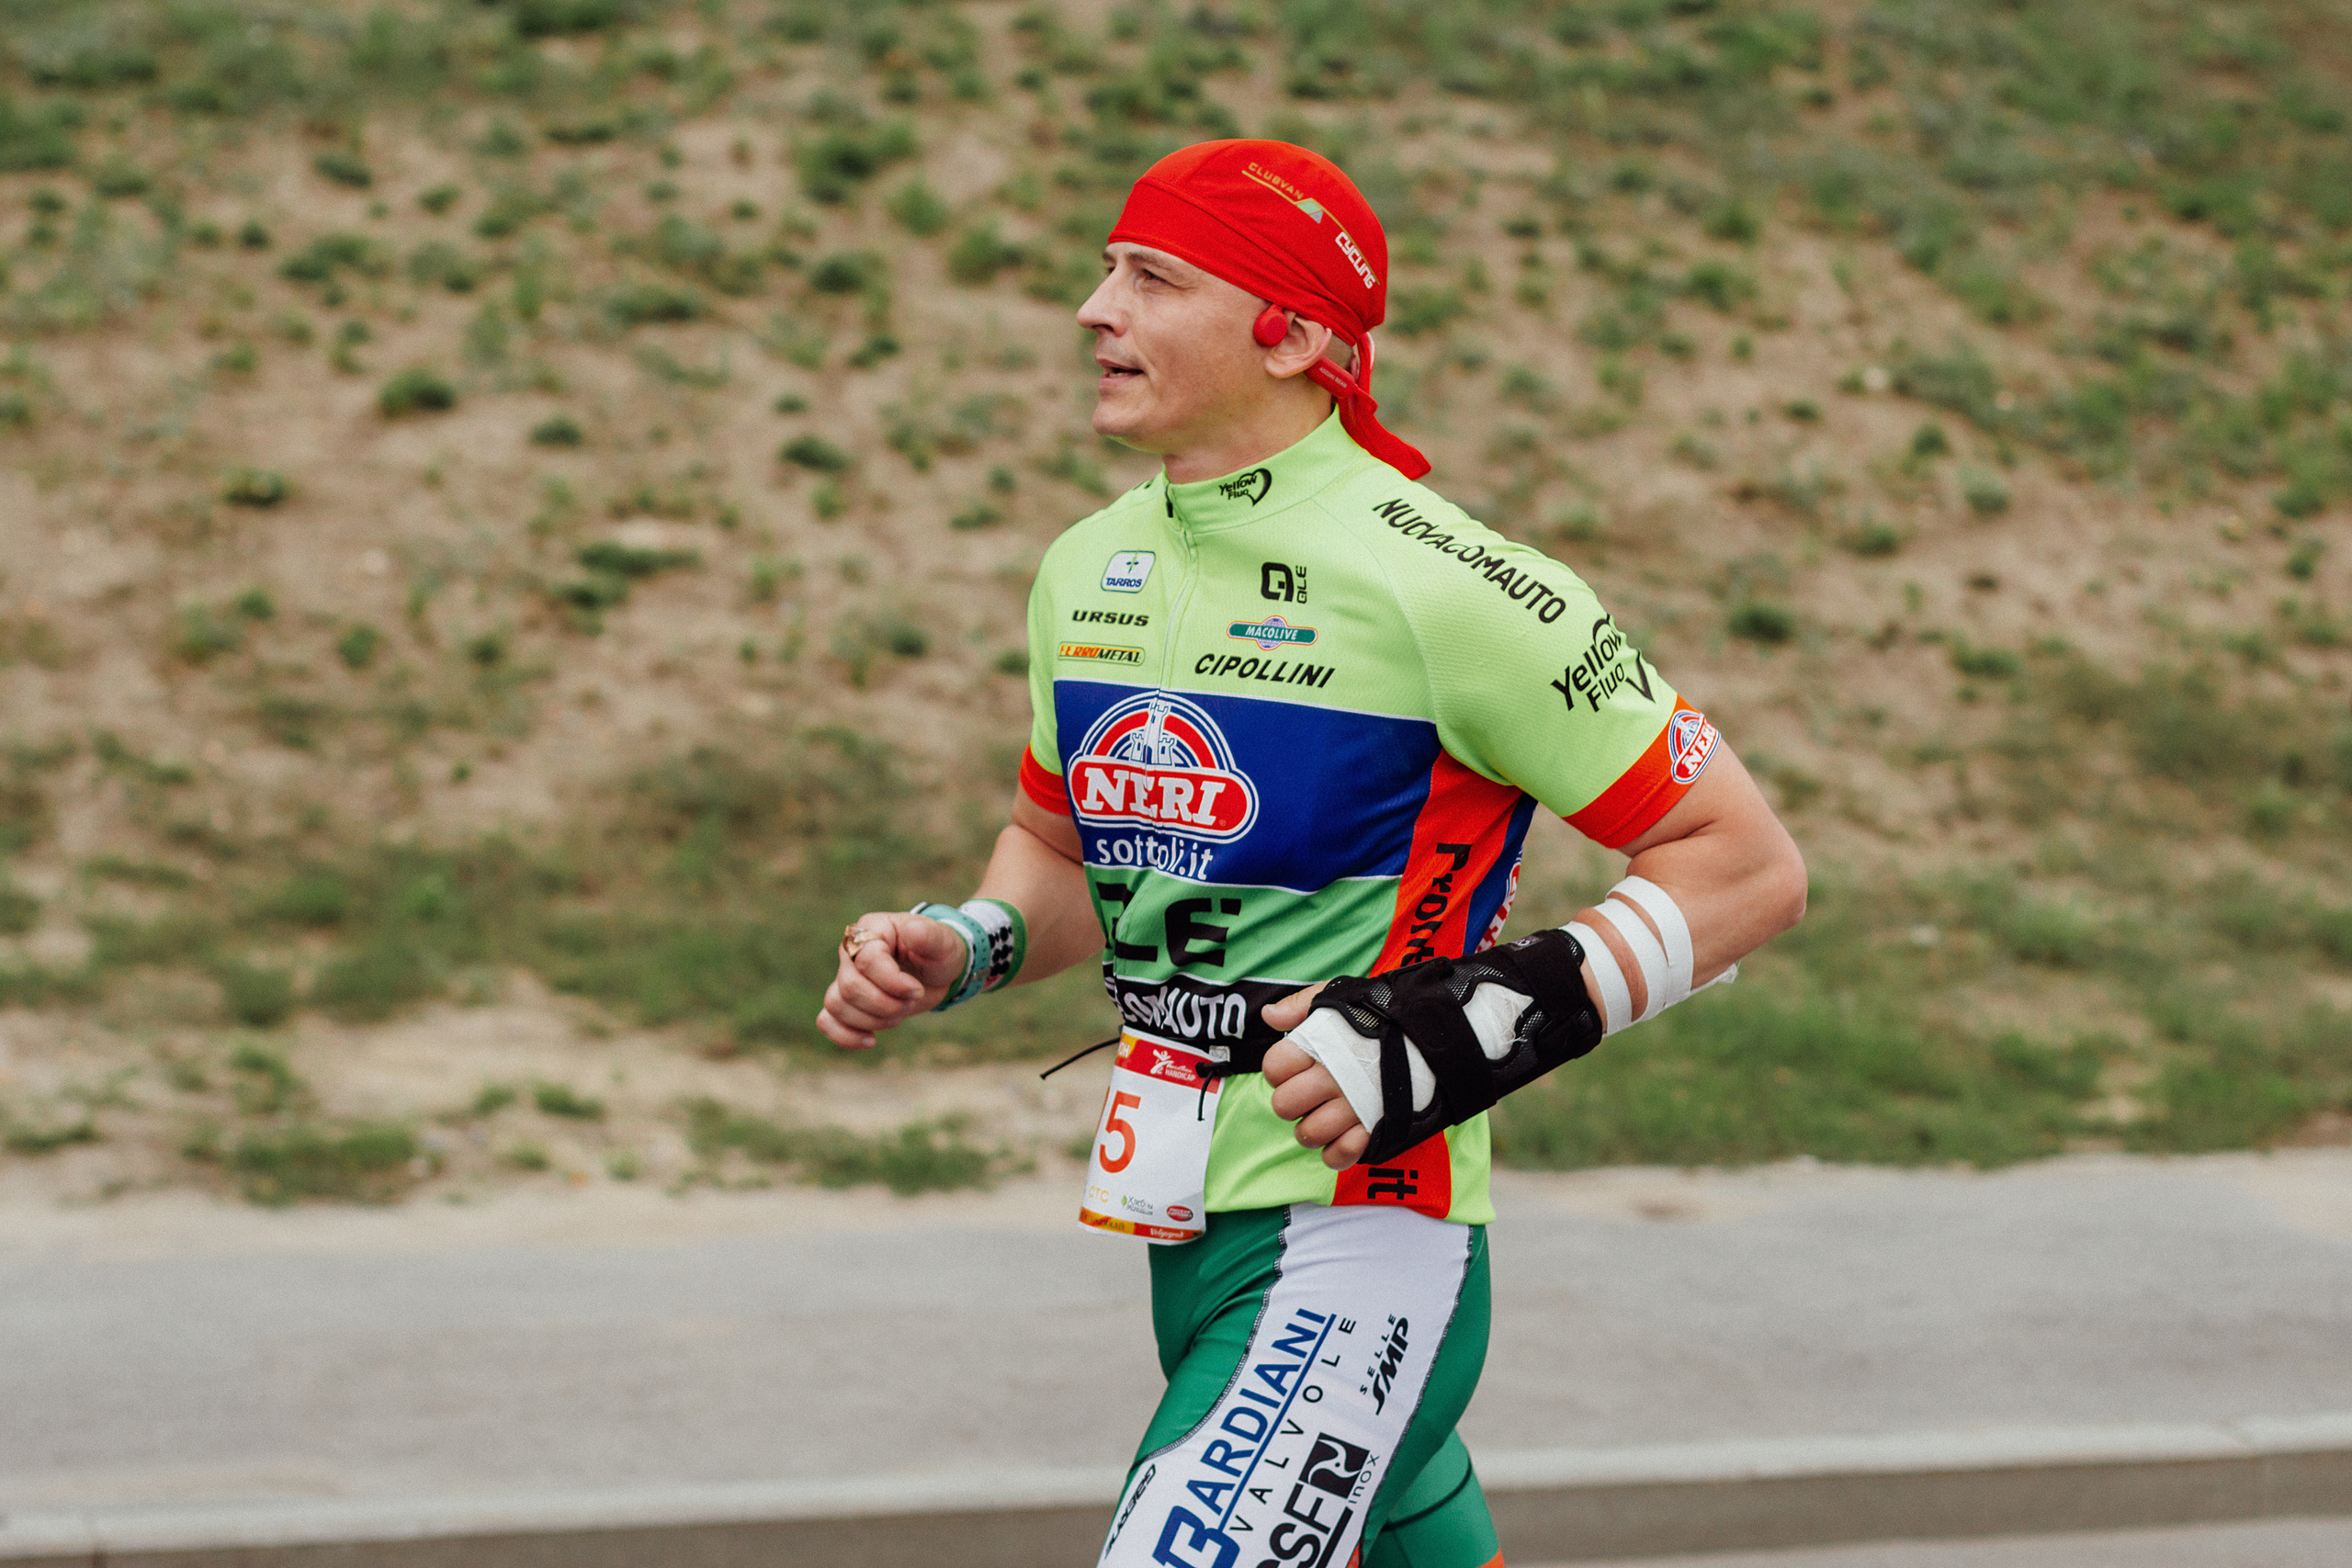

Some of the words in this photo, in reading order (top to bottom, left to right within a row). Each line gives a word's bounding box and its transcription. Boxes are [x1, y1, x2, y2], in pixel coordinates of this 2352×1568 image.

[1248, 162, 1304, 199] CLUBVAN
[1335, 231, 1376, 289] CYCLING
[1218, 475, 1257, 496] Yellow
[1227, 488, 1250, 501] Fluo
[1105, 577, 1143, 588] TARROS
[1372, 498, 1566, 624] NUOVACOMAUTO
[1071, 609, 1149, 627] URSUS
[1243, 625, 1299, 641] MACOLIVE
[1194, 653, 1336, 689] CIPOLLINI
[1550, 629, 1622, 712] Yellow
[1586, 662, 1625, 713] Fluo
[1080, 766, 1227, 827] NERI
[1096, 833, 1214, 881] sottoli.it
[1165, 1068, 1196, 1082] HANDICAP
[1359, 1313, 1397, 1395] SELLE
[1374, 1317, 1410, 1416] SMP
[1152, 1308, 1329, 1568] BARDIANI
[1228, 1316, 1357, 1533] VALVOLE
